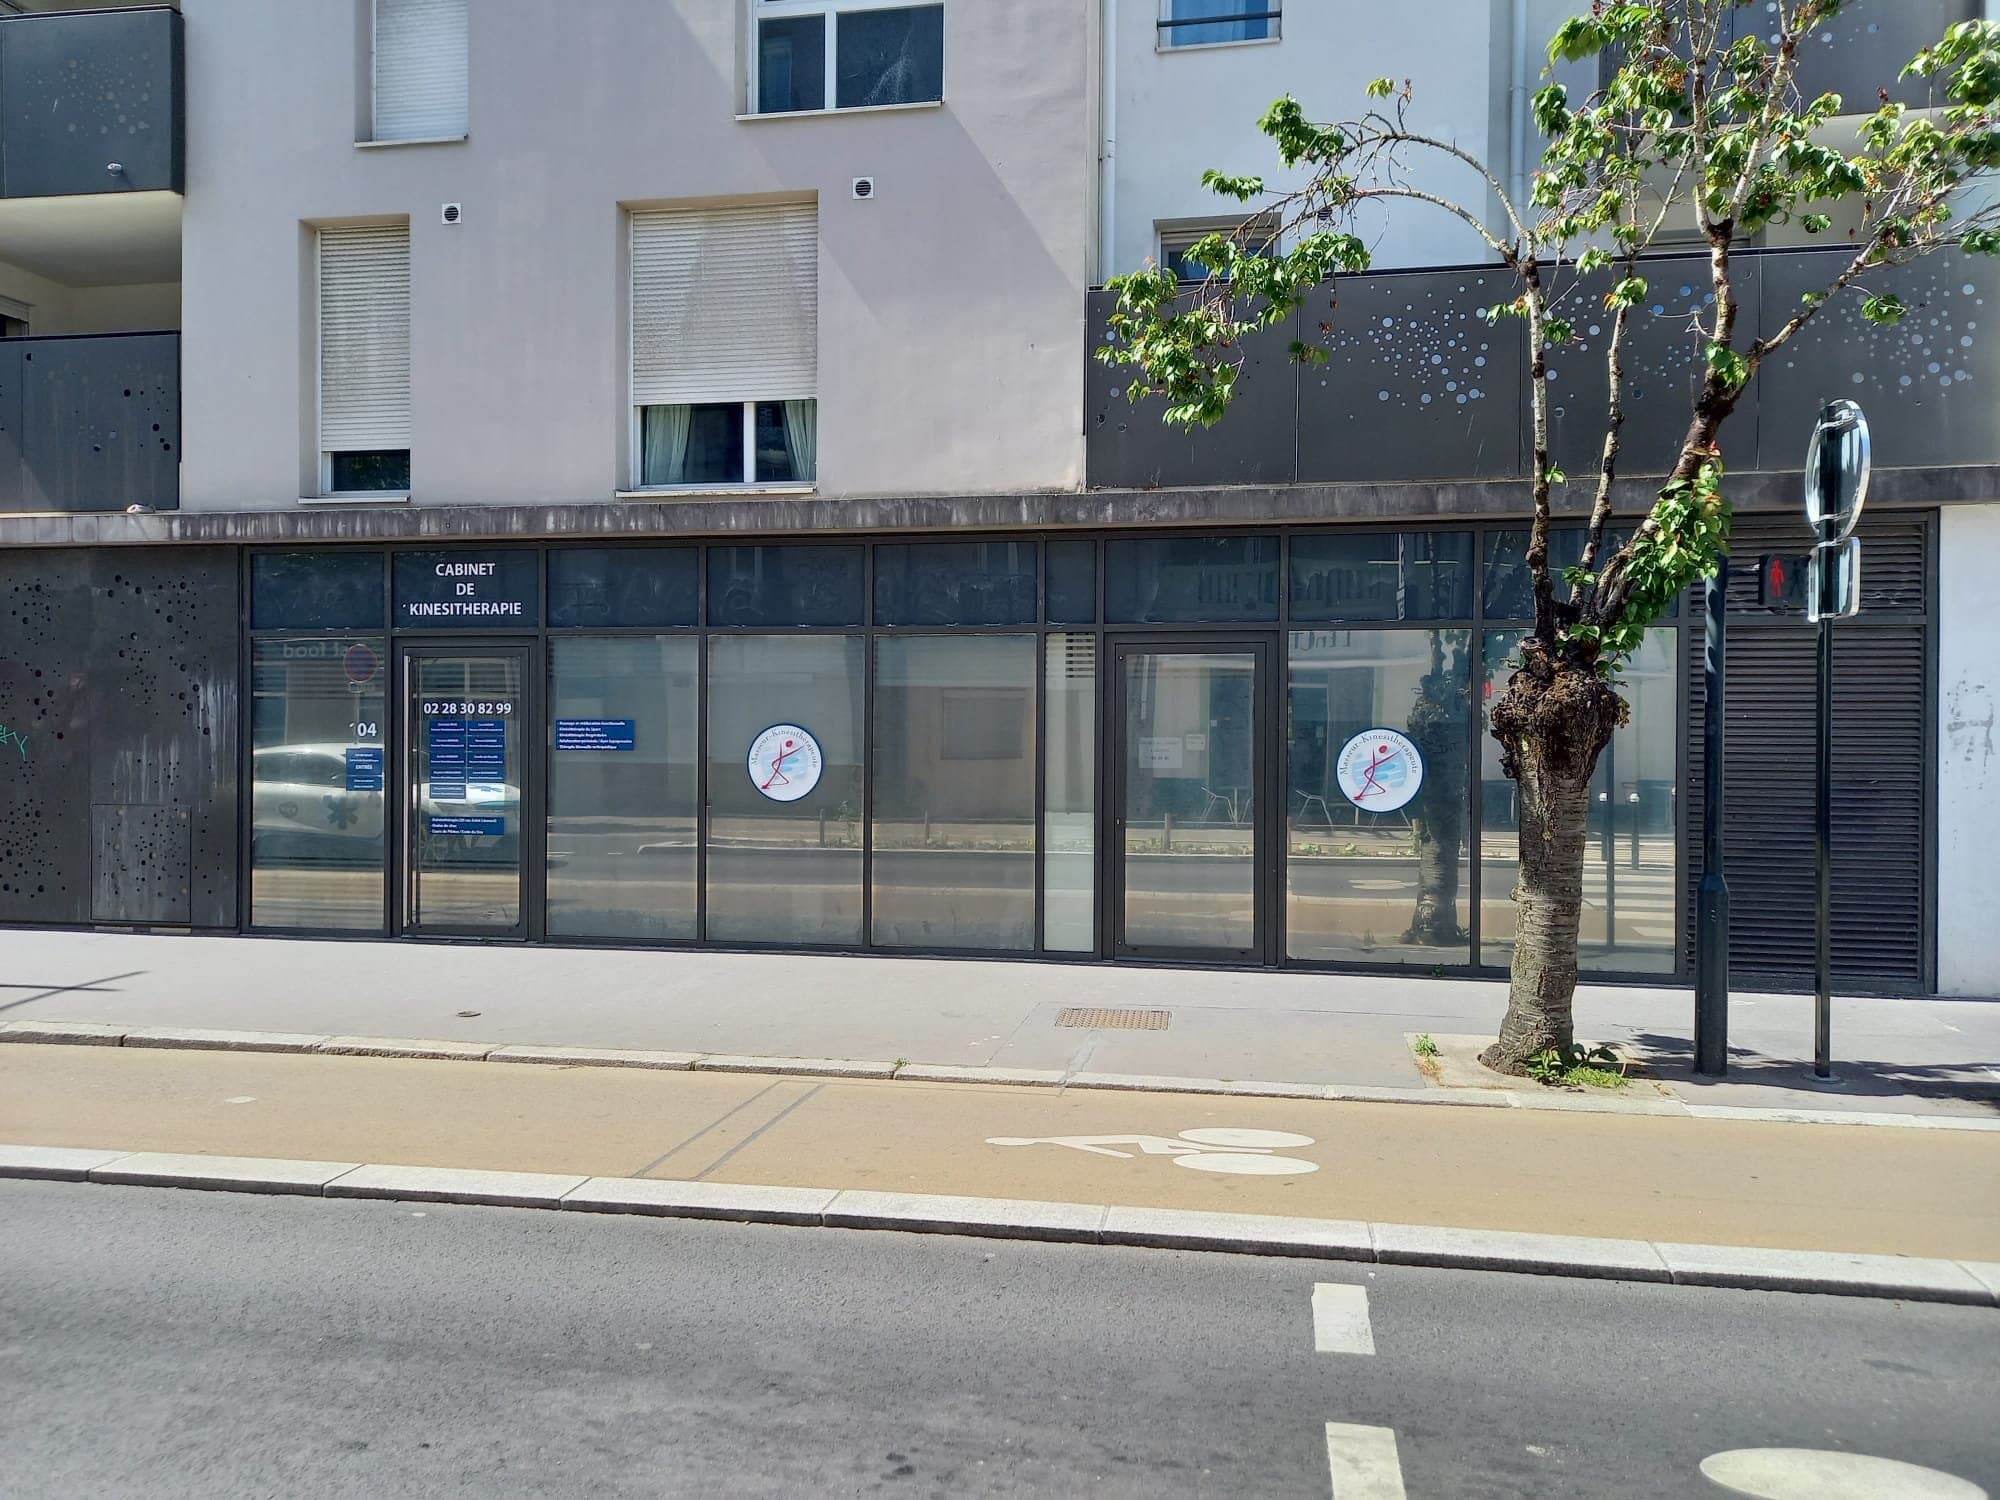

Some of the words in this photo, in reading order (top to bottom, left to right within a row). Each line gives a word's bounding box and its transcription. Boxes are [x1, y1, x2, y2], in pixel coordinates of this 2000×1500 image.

[435, 563, 495, 576] CABINET
[456, 583, 475, 596] DE
[409, 602, 522, 615] KINESITHERAPIE
[423, 702, 439, 714] 02
[441, 702, 457, 714] 28
[460, 702, 475, 714] 30
[478, 702, 493, 714] 82
[496, 702, 512, 714] 99
